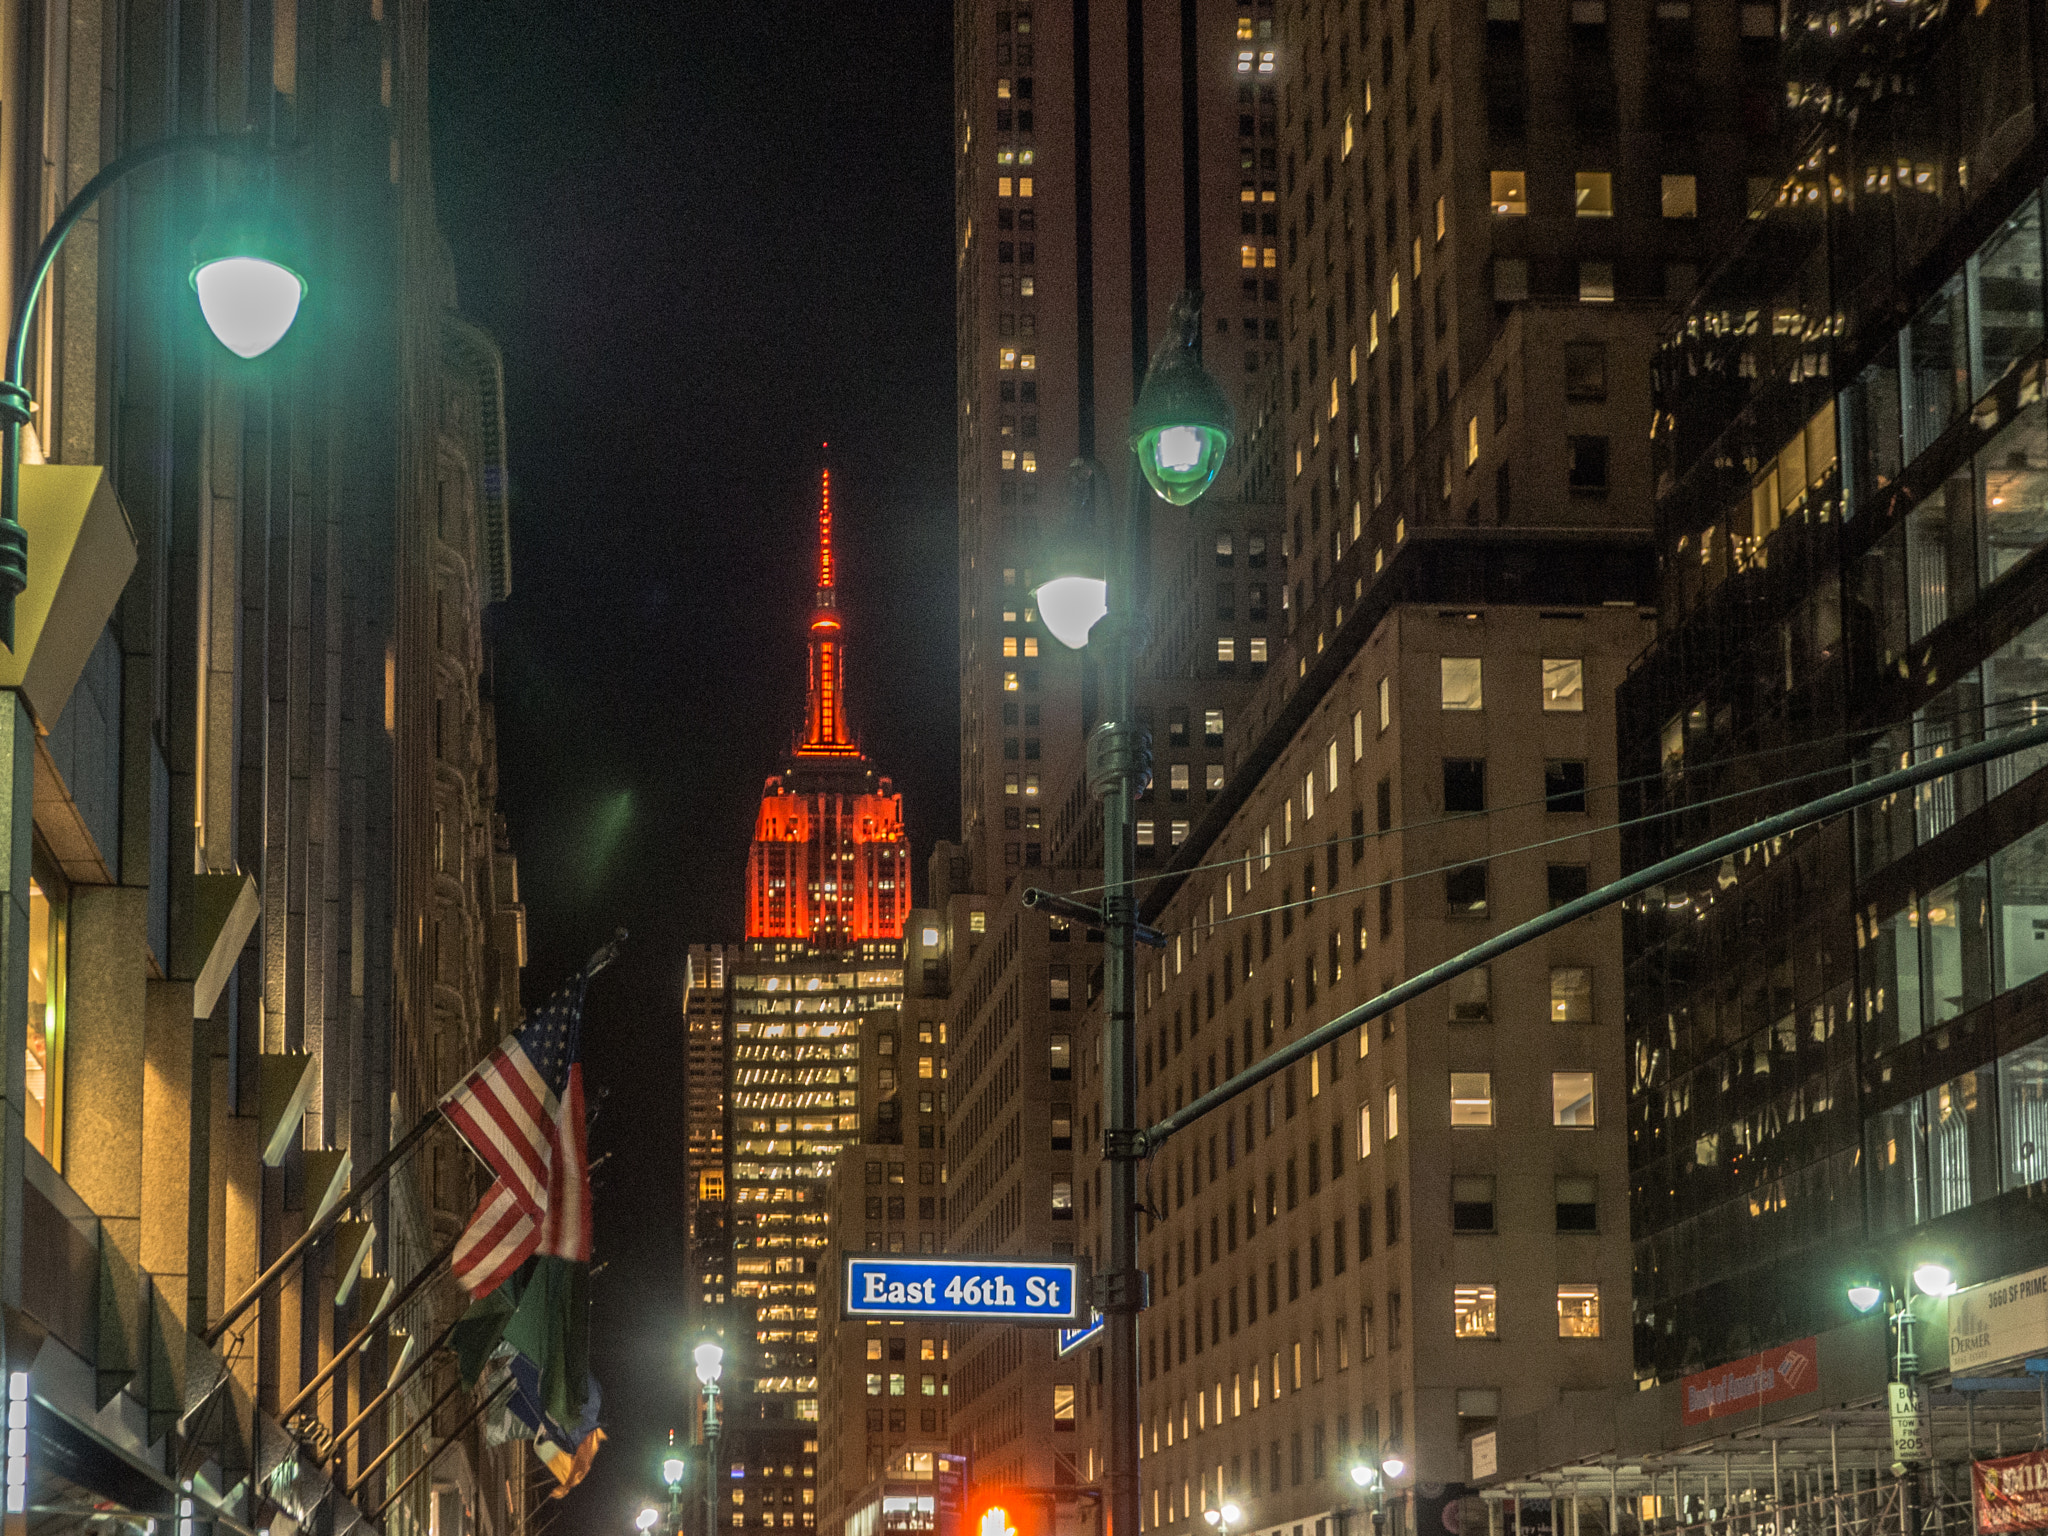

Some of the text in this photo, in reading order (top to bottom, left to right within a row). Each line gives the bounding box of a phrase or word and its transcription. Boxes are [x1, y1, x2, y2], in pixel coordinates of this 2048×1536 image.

[863, 1272, 1060, 1307] East 46th St
[2009, 1284, 2019, 1303] SF
[2020, 1275, 2048, 1299] PRIME
[1951, 1332, 1991, 1355] DERMER
[1728, 1364, 1775, 1400] America
[1899, 1387, 1920, 1399] BUS
[1896, 1402, 1923, 1413] LANE
